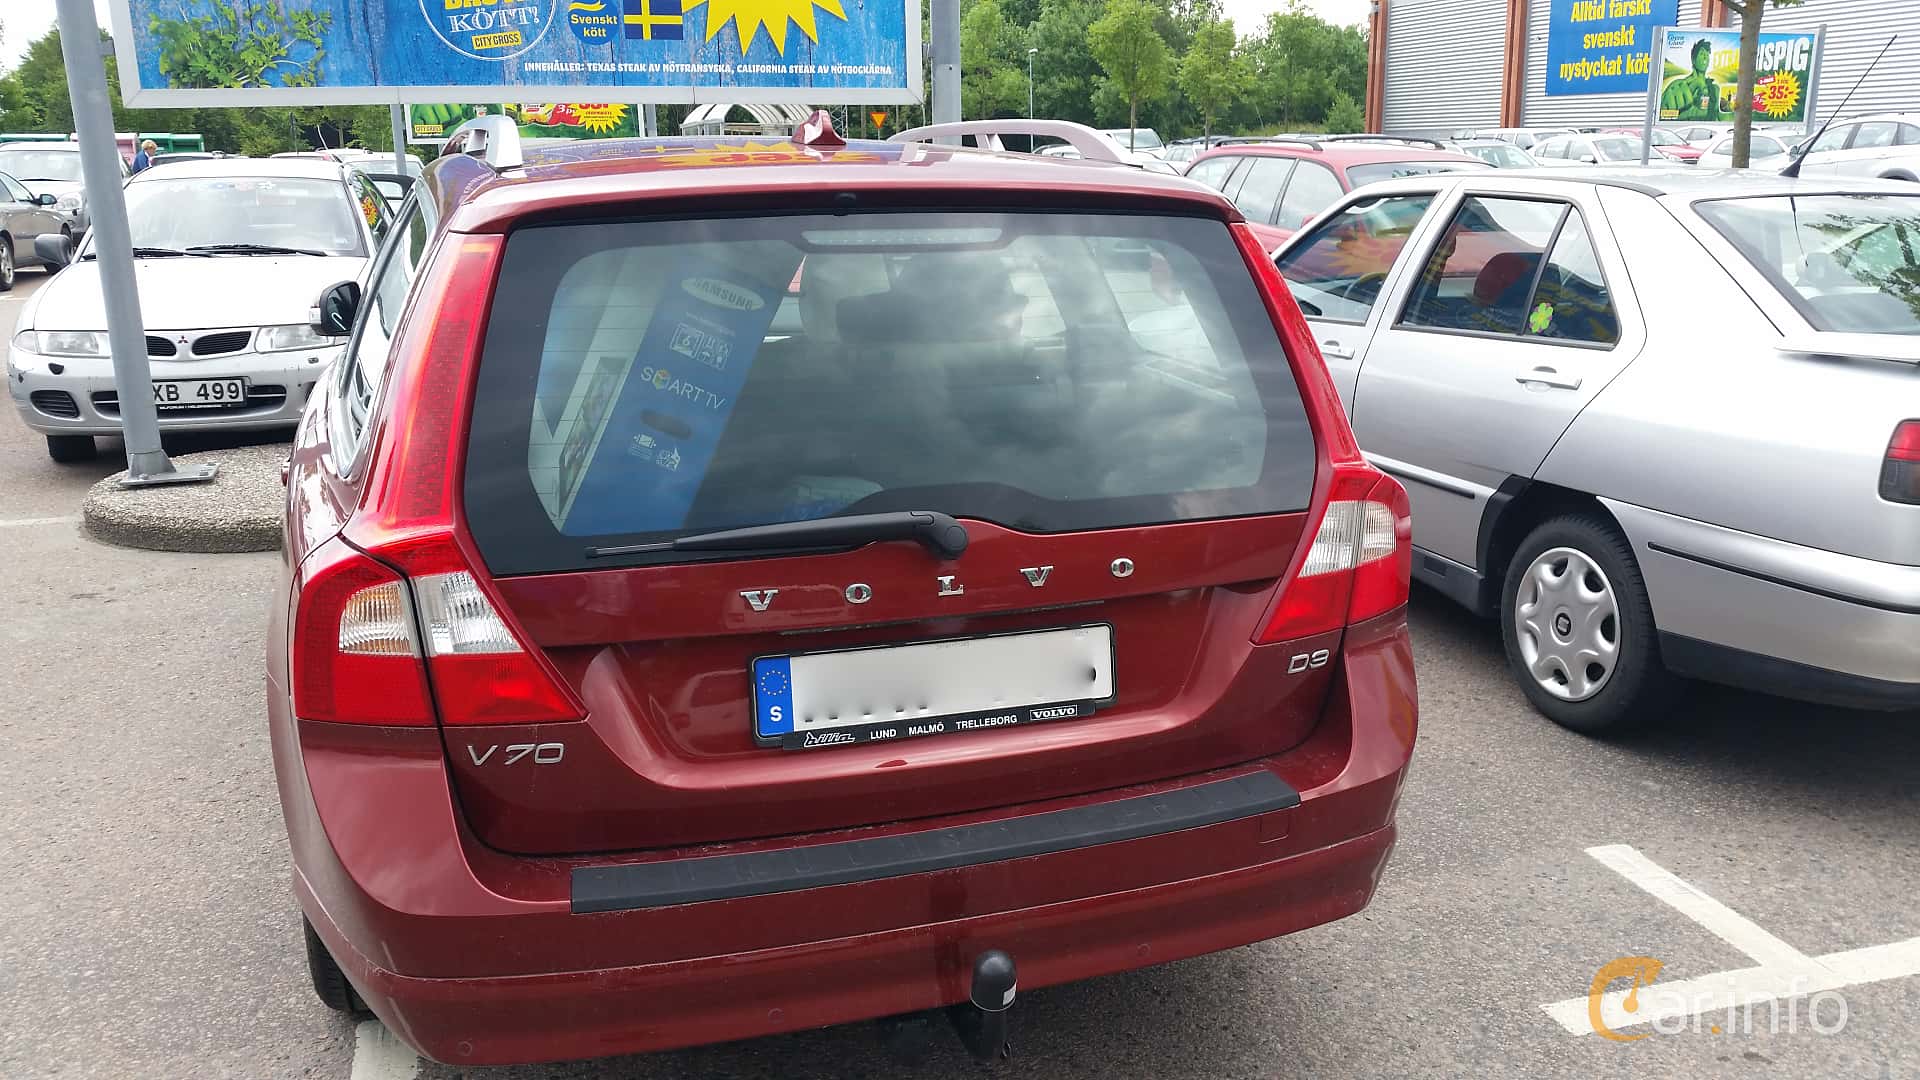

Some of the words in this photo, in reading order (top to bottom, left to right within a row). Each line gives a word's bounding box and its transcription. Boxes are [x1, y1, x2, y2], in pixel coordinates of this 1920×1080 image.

[447, 6, 540, 32] KÖTT!
[571, 13, 618, 24] Svenskt
[1570, 0, 1606, 22] Alltid
[1609, 0, 1652, 18] färskt
[474, 35, 493, 47] CITY
[493, 33, 519, 45] GROSS
[583, 26, 607, 38] kött
[1583, 24, 1636, 49] svenskt
[1755, 37, 1810, 72] ISPIG
[524, 60, 584, 72] INNEHÅLLER:
[587, 62, 616, 72] TEXAS
[618, 63, 646, 72] STEAK
[649, 63, 660, 73] AV
[737, 63, 787, 74] CALIFORNIA
[789, 65, 816, 74] STEAK
[817, 65, 829, 74] AV
[1559, 54, 1623, 81] nystyckat
[1625, 52, 1651, 75] köt
[694, 278, 753, 311] SAMSUNG
[152, 384, 180, 402] XB
[196, 382, 240, 401] 499
[706, 391, 726, 409] TV
[740, 557, 1135, 612] VOLVO
[1287, 649, 1330, 674] D3
[769, 705, 783, 723] S
[870, 727, 897, 741] LUND
[908, 720, 945, 737] MALMÖ
[955, 713, 1018, 731] TRELLEBORG
[1032, 707, 1075, 719] VOLVO
